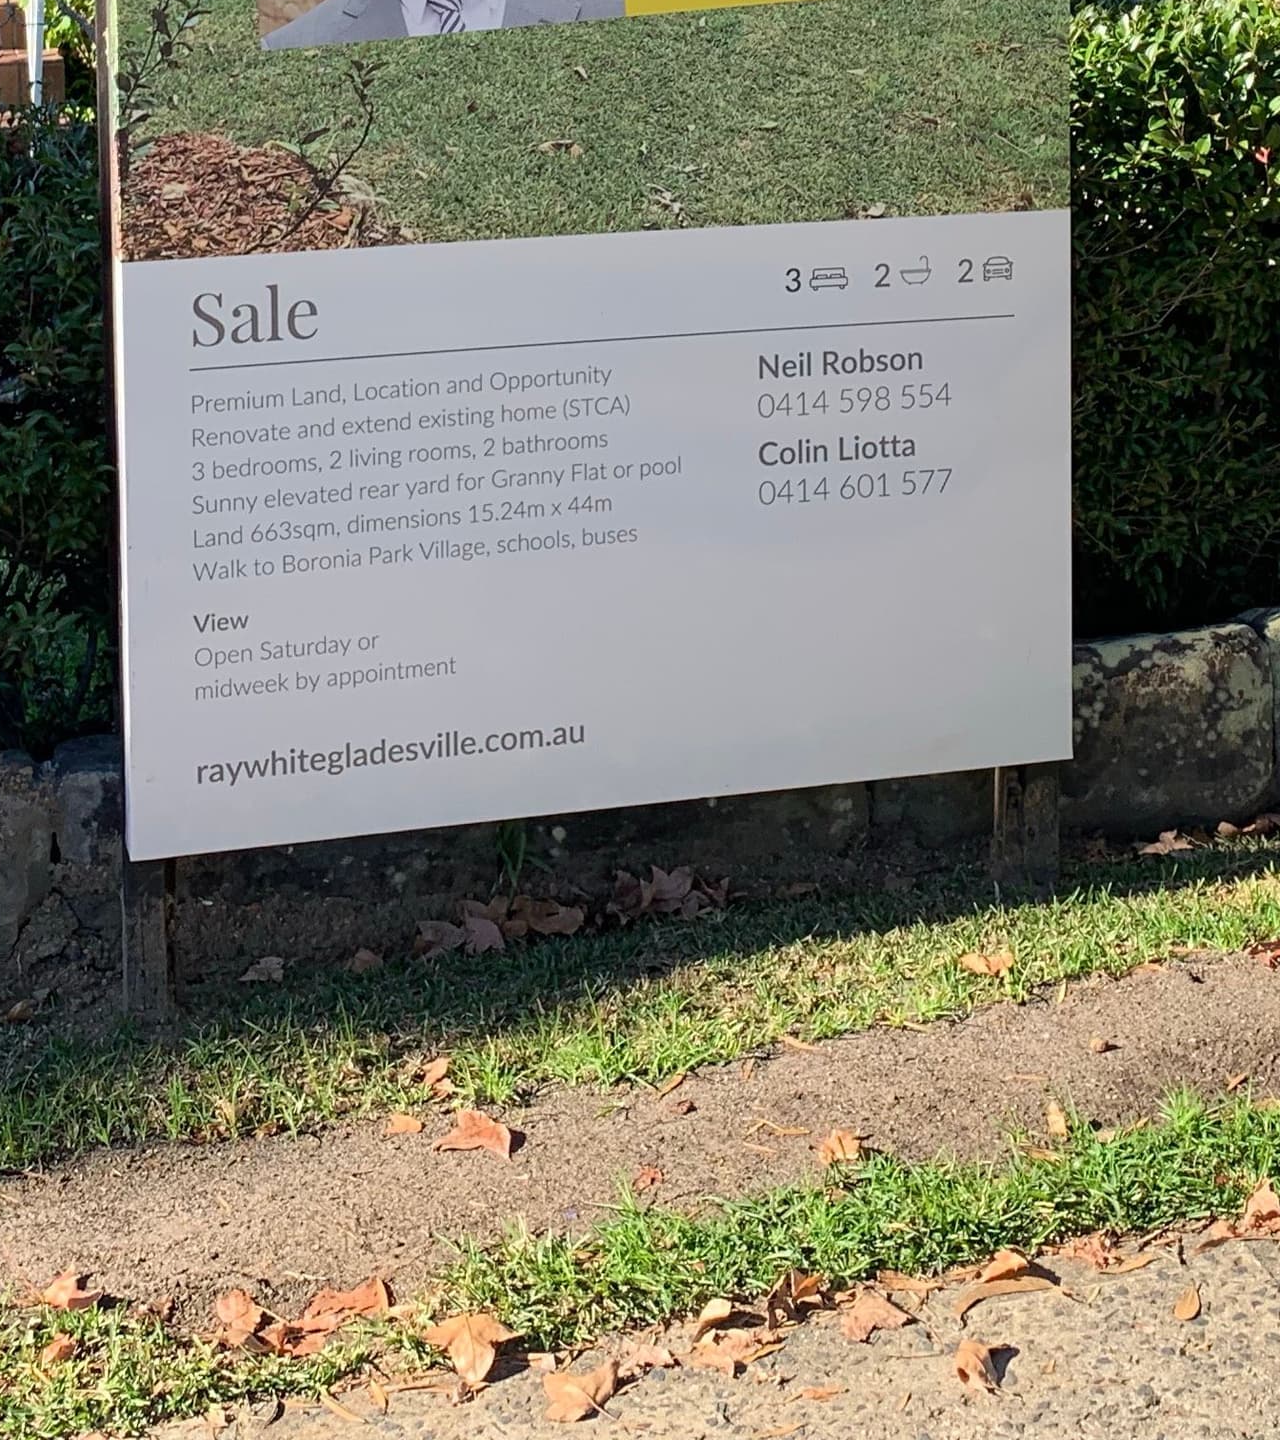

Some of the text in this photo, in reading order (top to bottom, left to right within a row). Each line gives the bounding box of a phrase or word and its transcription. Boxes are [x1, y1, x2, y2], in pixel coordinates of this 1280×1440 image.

[785, 260, 974, 293] 3 2 2
[193, 284, 318, 347] Sale
[759, 348, 923, 380] Neil Robson
[192, 366, 612, 414] Premium Land, Location and Opportunity
[758, 382, 952, 419] 0414 598 554
[192, 394, 630, 448] Renovate and extend existing home (STCA)
[192, 433, 608, 481] 3 bedrooms, 2 living rooms, 2 bathrooms
[759, 434, 916, 466] Colin Liotta
[192, 456, 681, 515] Sunny elevated rear yard for Granny Flat or pool
[759, 468, 952, 506] 0414 601 577
[194, 493, 612, 549] Land 663sqm, dimensions 15.24m x 44m
[193, 528, 638, 581] Walk to Boronia Park Village, schools, buses
[193, 612, 249, 633] View
[195, 635, 379, 670] Open Saturday or
[195, 657, 456, 701] midweek by appointment
[197, 725, 585, 786] raywhitegladesville.com.au
